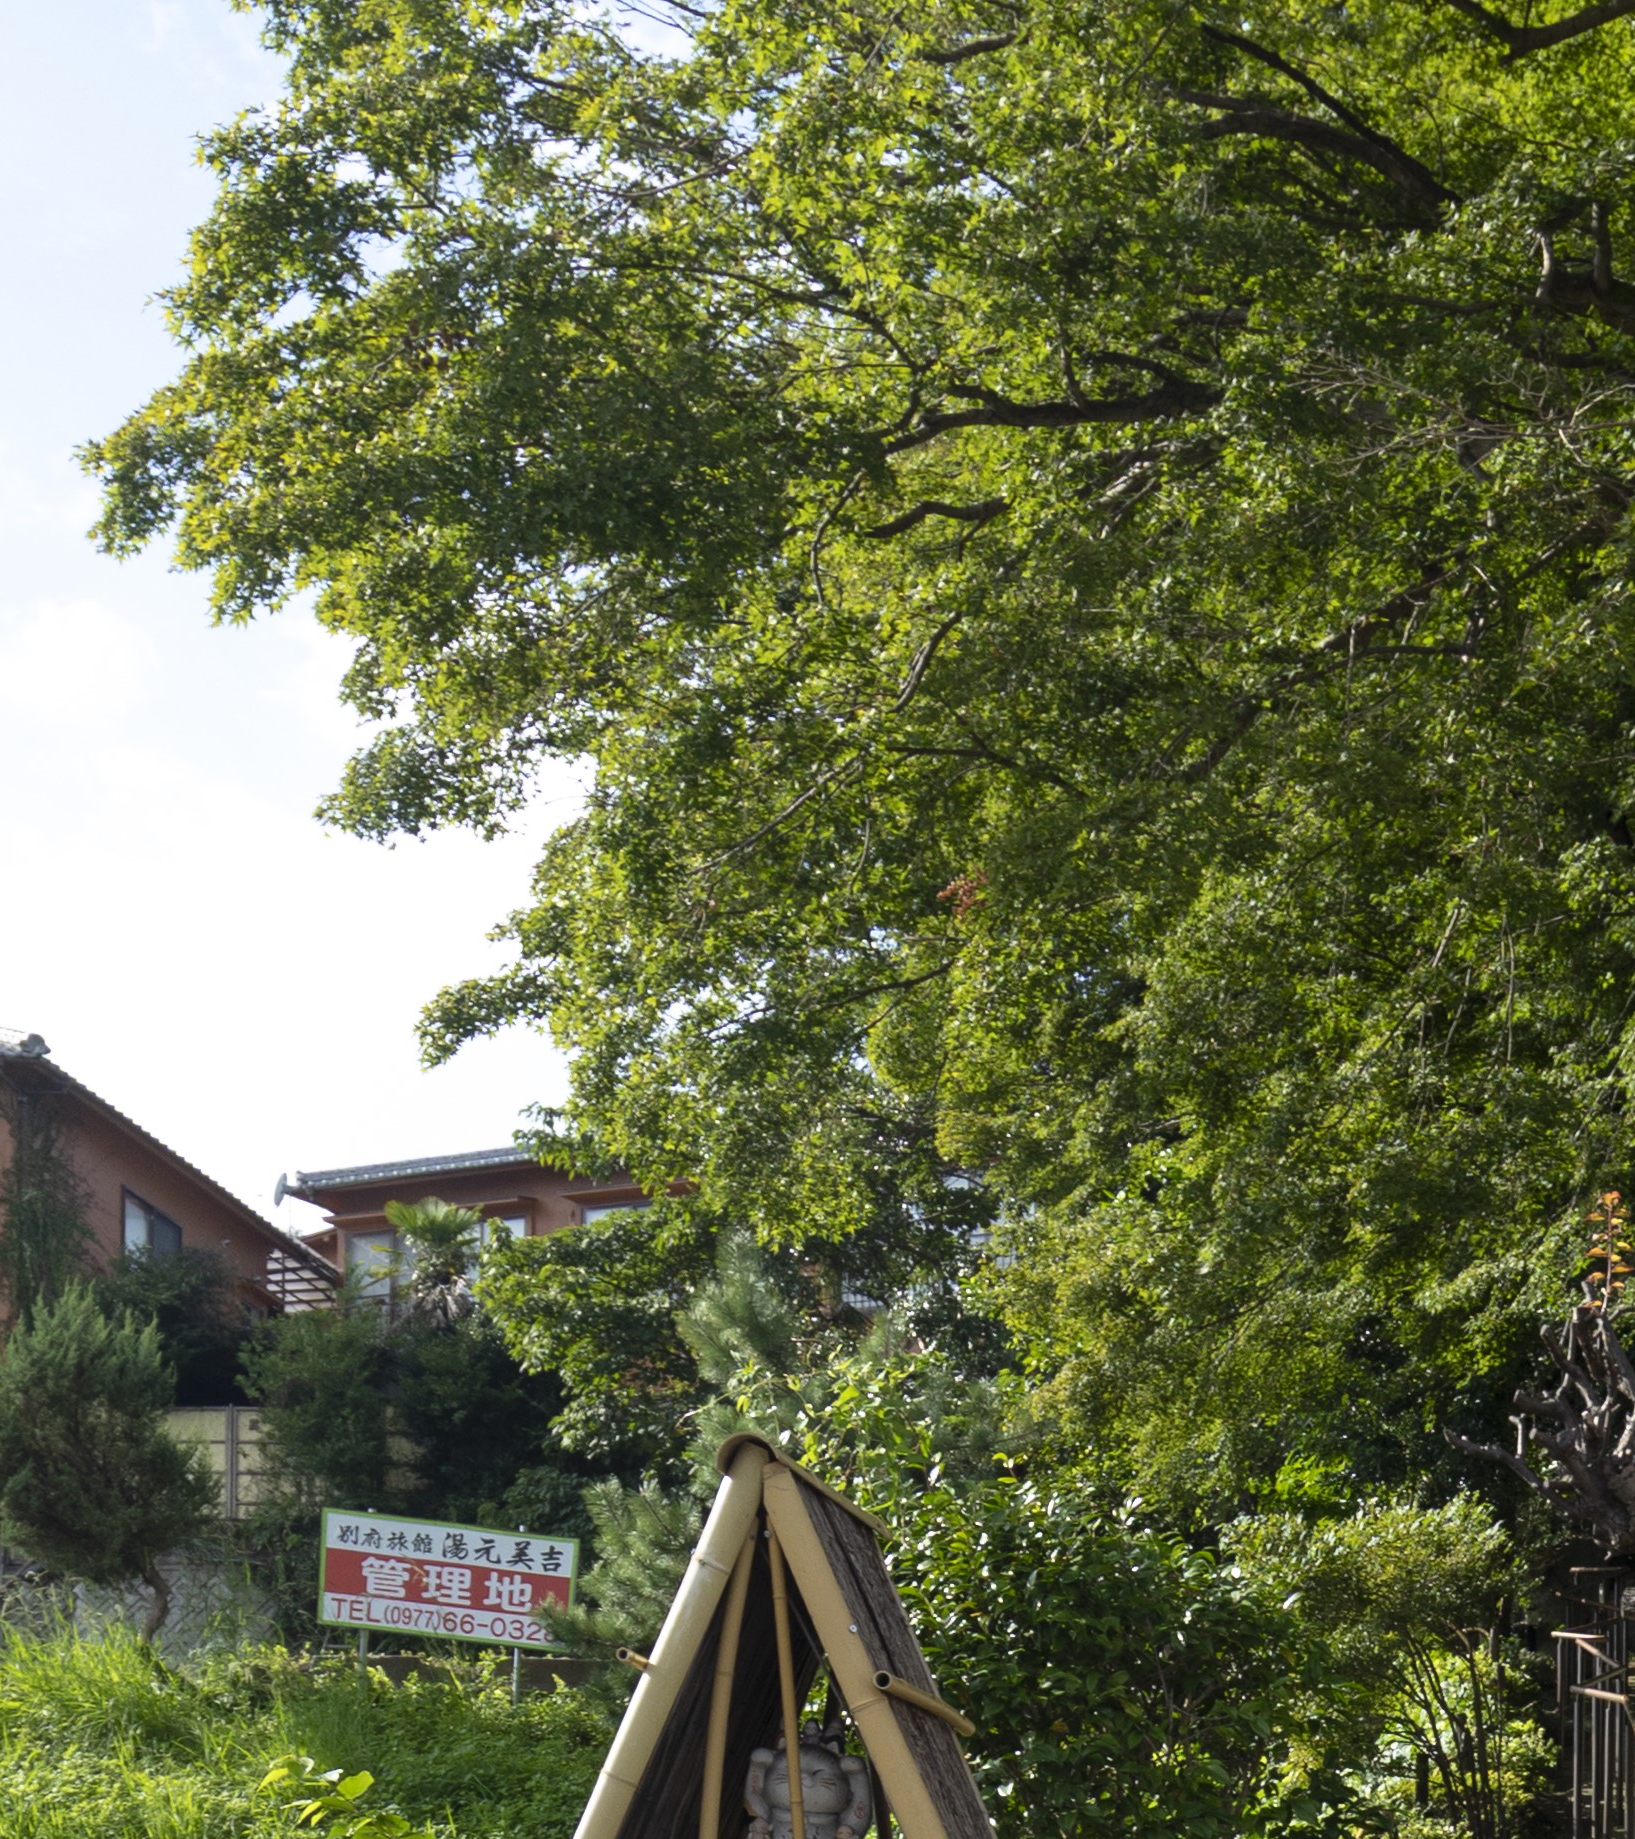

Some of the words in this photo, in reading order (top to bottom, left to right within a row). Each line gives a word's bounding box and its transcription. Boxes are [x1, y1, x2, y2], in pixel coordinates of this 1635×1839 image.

[337, 1524, 434, 1554] 別府旅館
[442, 1531, 565, 1573] 湯元美吉
[361, 1556, 533, 1613] 管理地
